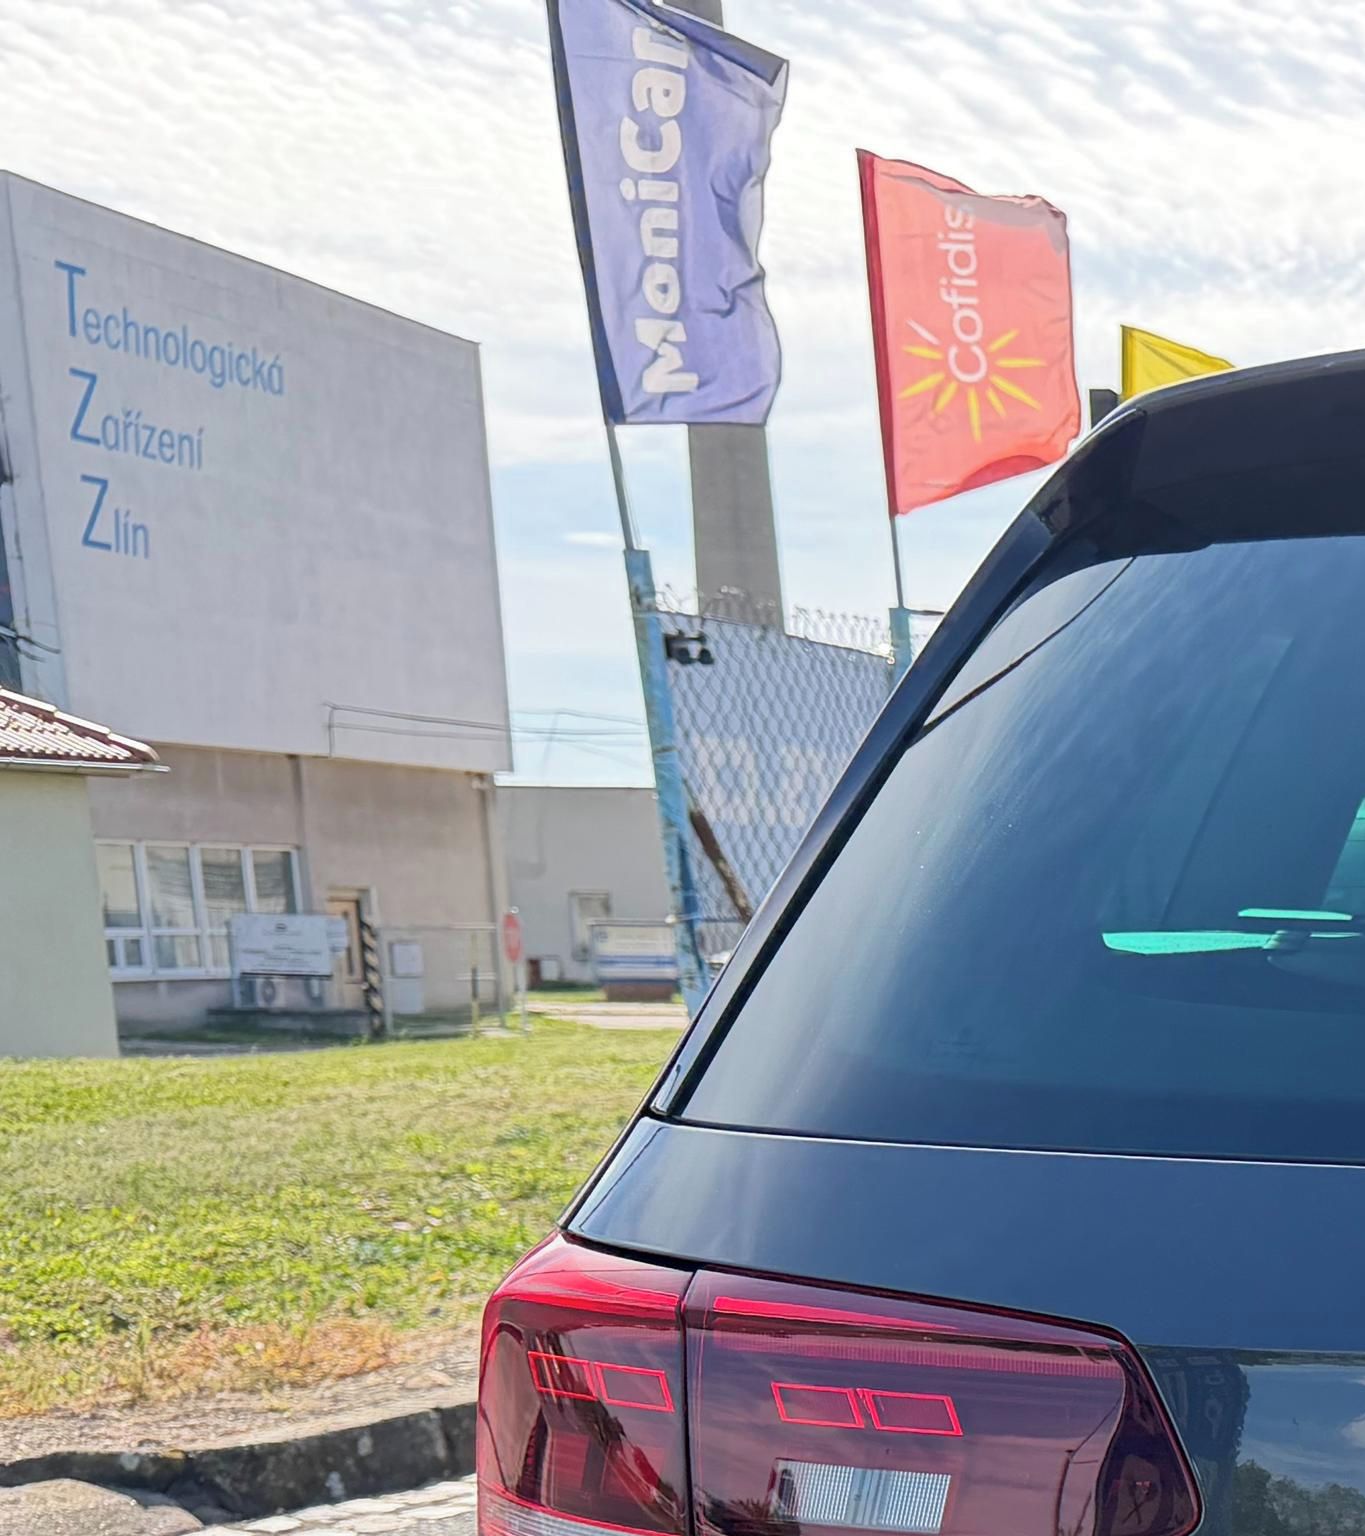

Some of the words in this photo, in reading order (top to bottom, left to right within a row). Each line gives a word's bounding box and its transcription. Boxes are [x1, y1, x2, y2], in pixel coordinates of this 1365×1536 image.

[55, 260, 284, 395] Technologická
[937, 204, 988, 383] Cofidis
[69, 368, 204, 470] Zařízení
[81, 475, 150, 559] Zlín
